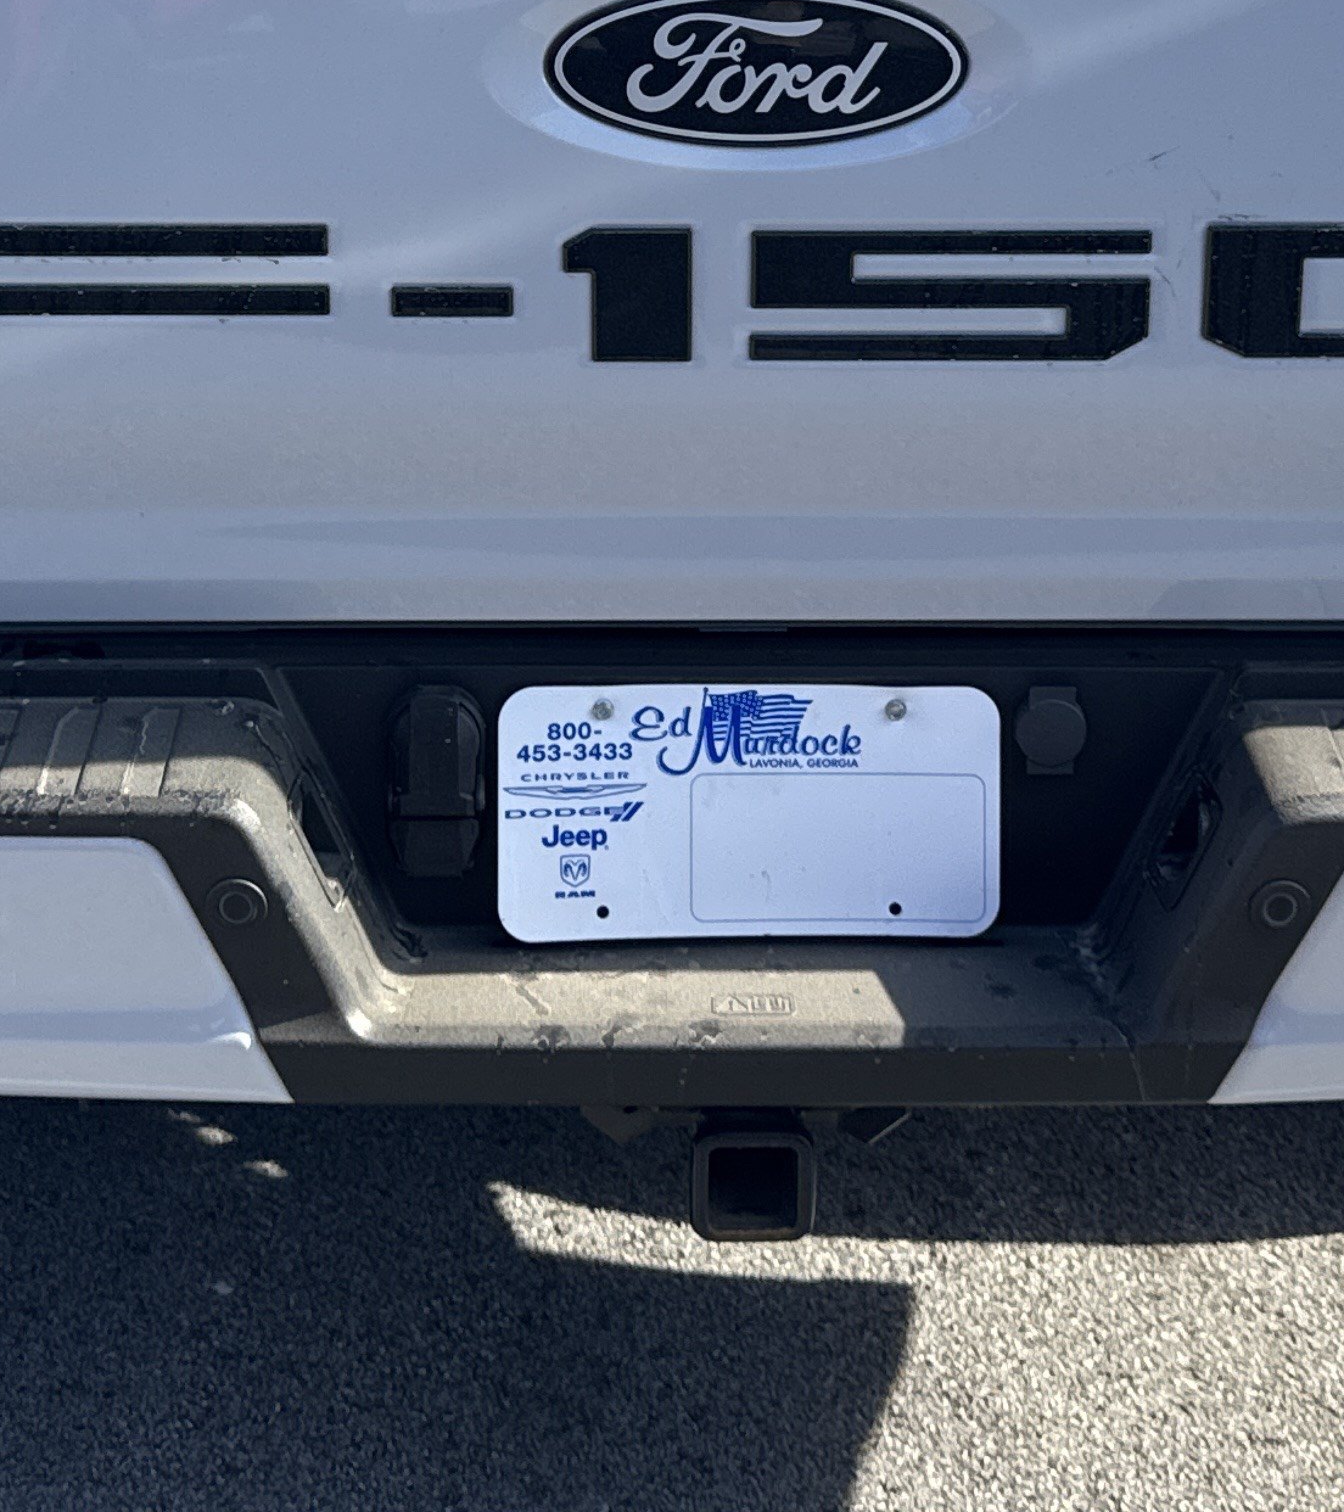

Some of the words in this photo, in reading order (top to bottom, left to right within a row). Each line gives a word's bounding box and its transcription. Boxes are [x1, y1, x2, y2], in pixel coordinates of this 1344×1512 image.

[626, 12, 888, 113] Ford
[547, 721, 602, 740] 800-
[629, 706, 692, 741] Ed
[657, 691, 862, 776] Murdock
[516, 742, 633, 763] 453-3433
[749, 758, 803, 769] LAVONIA,
[806, 758, 859, 768] GEORGIA
[520, 771, 629, 782] CHRYSLER
[541, 824, 608, 850] Jeep
[555, 890, 596, 899] RAM
